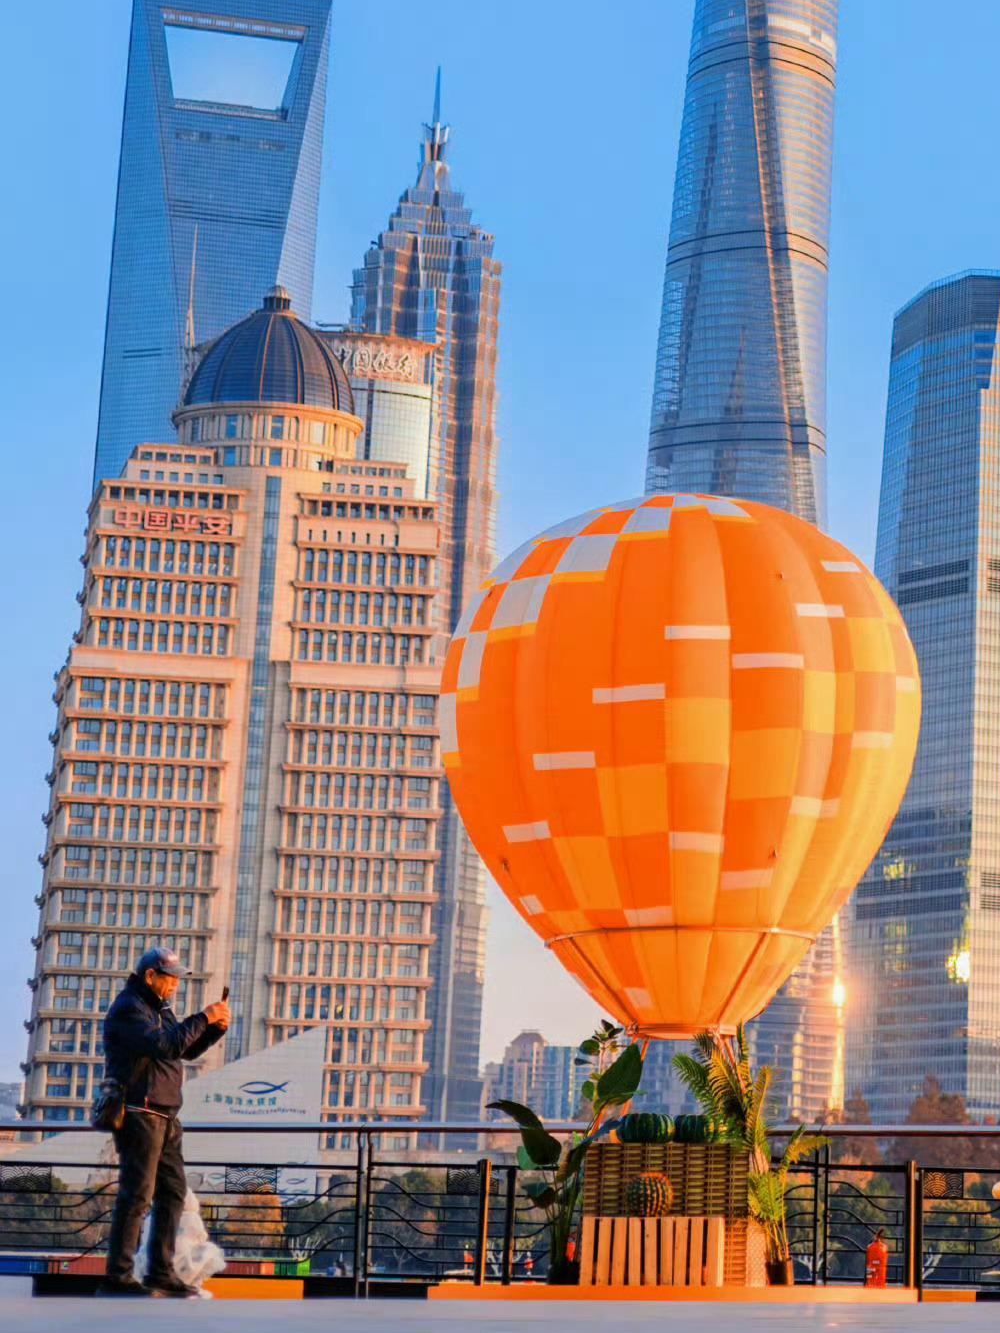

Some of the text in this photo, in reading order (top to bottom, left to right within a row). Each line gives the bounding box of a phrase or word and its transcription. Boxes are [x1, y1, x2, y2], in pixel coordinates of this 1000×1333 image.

[333, 345, 418, 379] 中国银行
[114, 506, 232, 535] 中国平安
